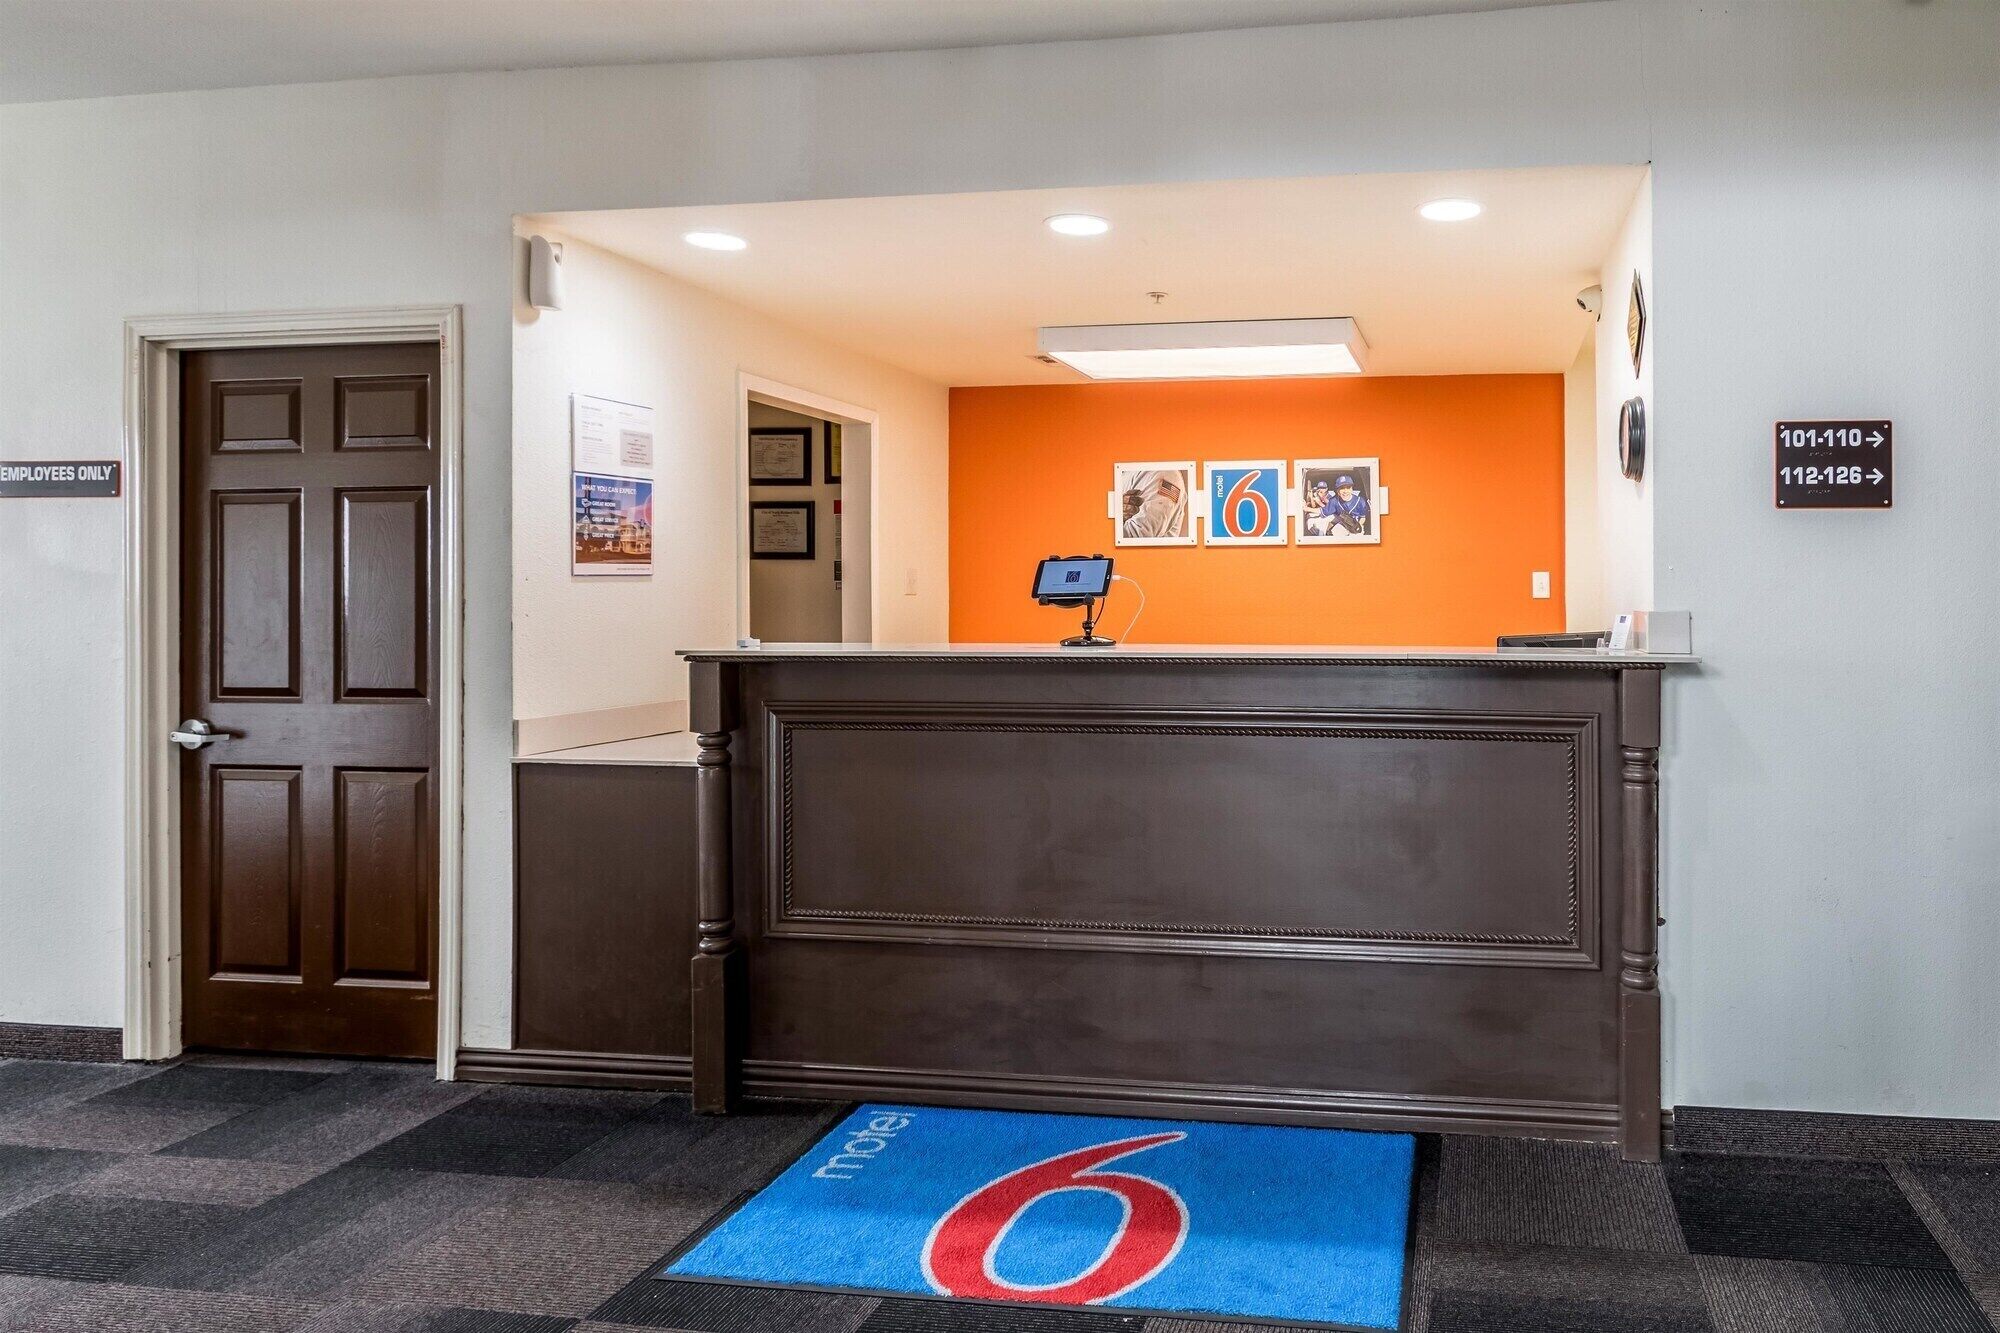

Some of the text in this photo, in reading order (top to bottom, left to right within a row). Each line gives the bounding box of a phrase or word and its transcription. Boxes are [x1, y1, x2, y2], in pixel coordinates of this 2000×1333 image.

[1780, 428, 1862, 448] 101-110
[1, 465, 112, 481] EMPLOYEES ONLY
[1780, 466, 1862, 485] 112-126
[597, 485, 608, 493] YOU
[1216, 470, 1271, 537] motel 6
[812, 1110, 1190, 1306] motel 6
